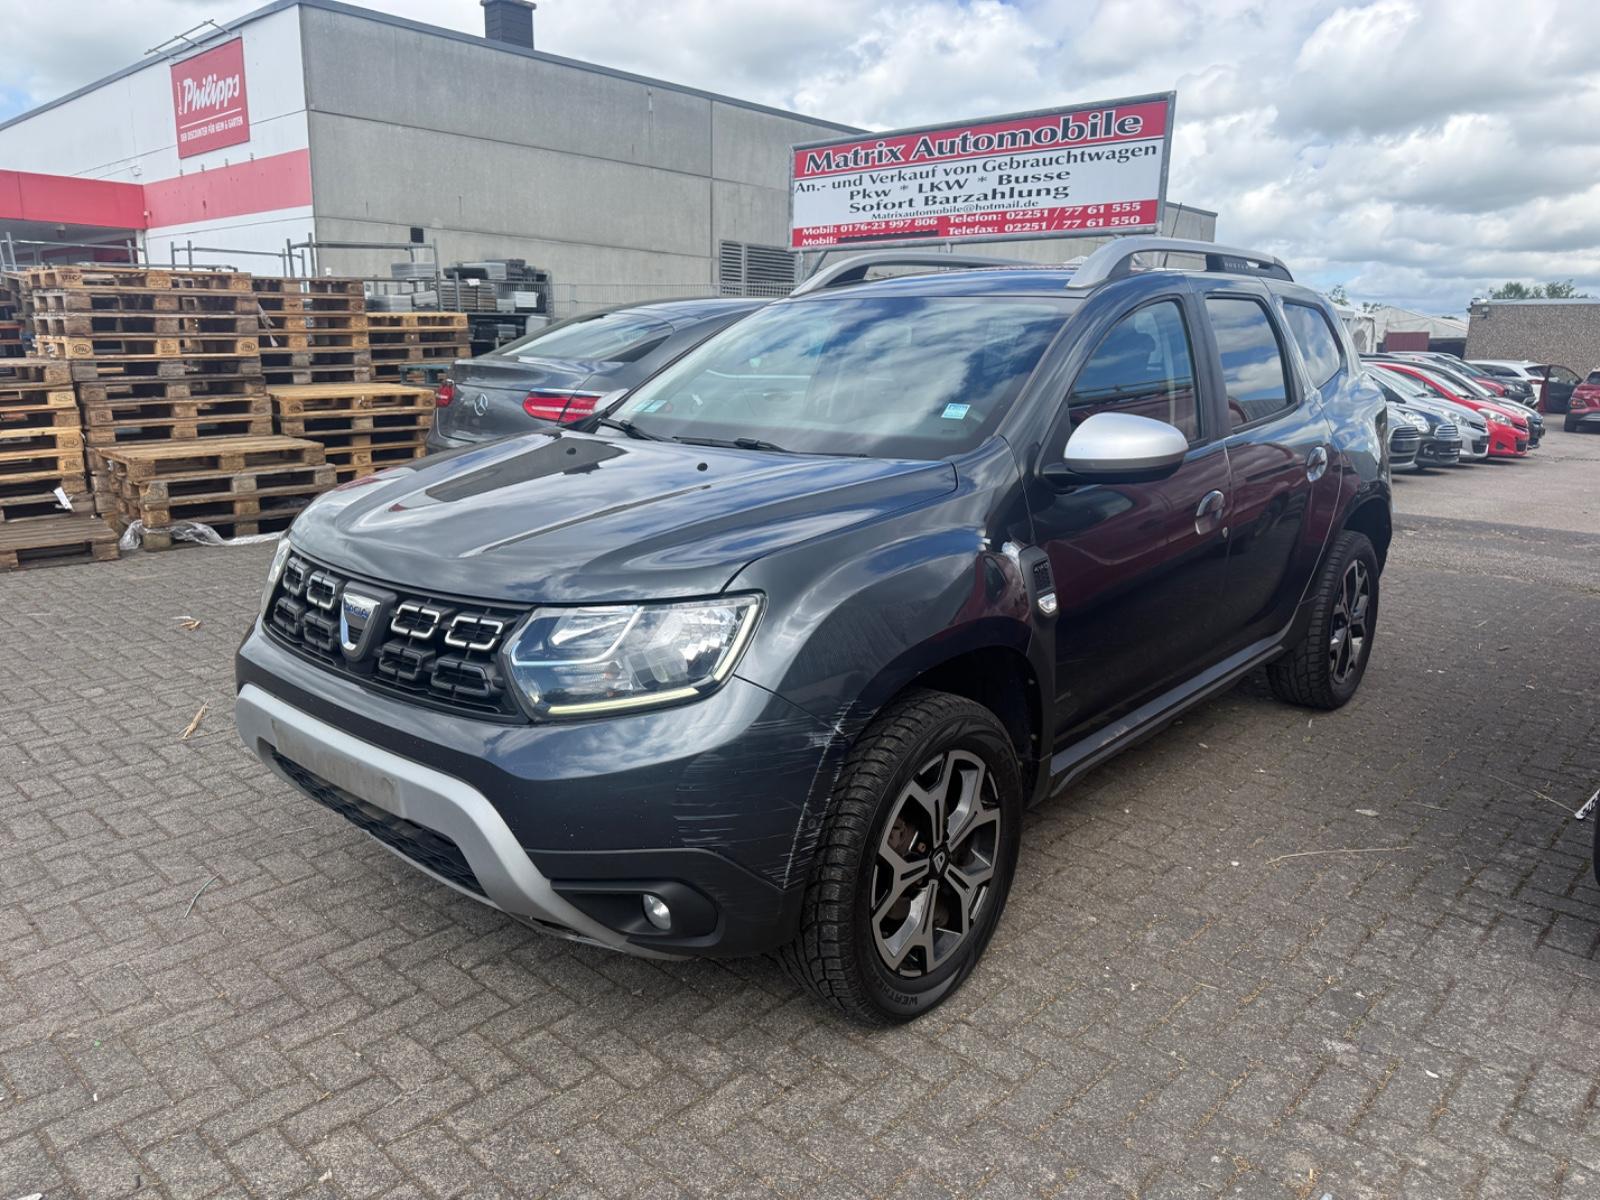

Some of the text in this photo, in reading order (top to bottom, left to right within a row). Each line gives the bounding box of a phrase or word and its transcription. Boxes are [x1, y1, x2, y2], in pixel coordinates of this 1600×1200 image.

[183, 73, 240, 115] Philipps
[804, 110, 1143, 175] Matrix Automobile
[832, 174, 863, 189] und
[869, 166, 938, 184] Verkauf
[943, 163, 977, 175] von
[982, 144, 1157, 173] Gebrauchtwagen
[849, 170, 1071, 201] Pkw LKW Busse
[849, 185, 1070, 214] Sofort Barzahlung
[871, 199, 1039, 220] Matrixautomobile@hotmail.de
[948, 213, 1002, 224] Telefon:
[1006, 209, 1048, 220] 02251
[1064, 206, 1086, 216] 77
[1087, 204, 1105, 215] 61
[1111, 202, 1141, 213] 555
[948, 225, 999, 236] Telefax:
[1004, 222, 1047, 233] 02251
[1062, 219, 1083, 229] 77
[1086, 217, 1105, 227] 61
[1110, 215, 1141, 225] 550
[802, 224, 837, 236] Mobil:
[889, 219, 912, 229] 997
[801, 236, 838, 246] Mobil:
